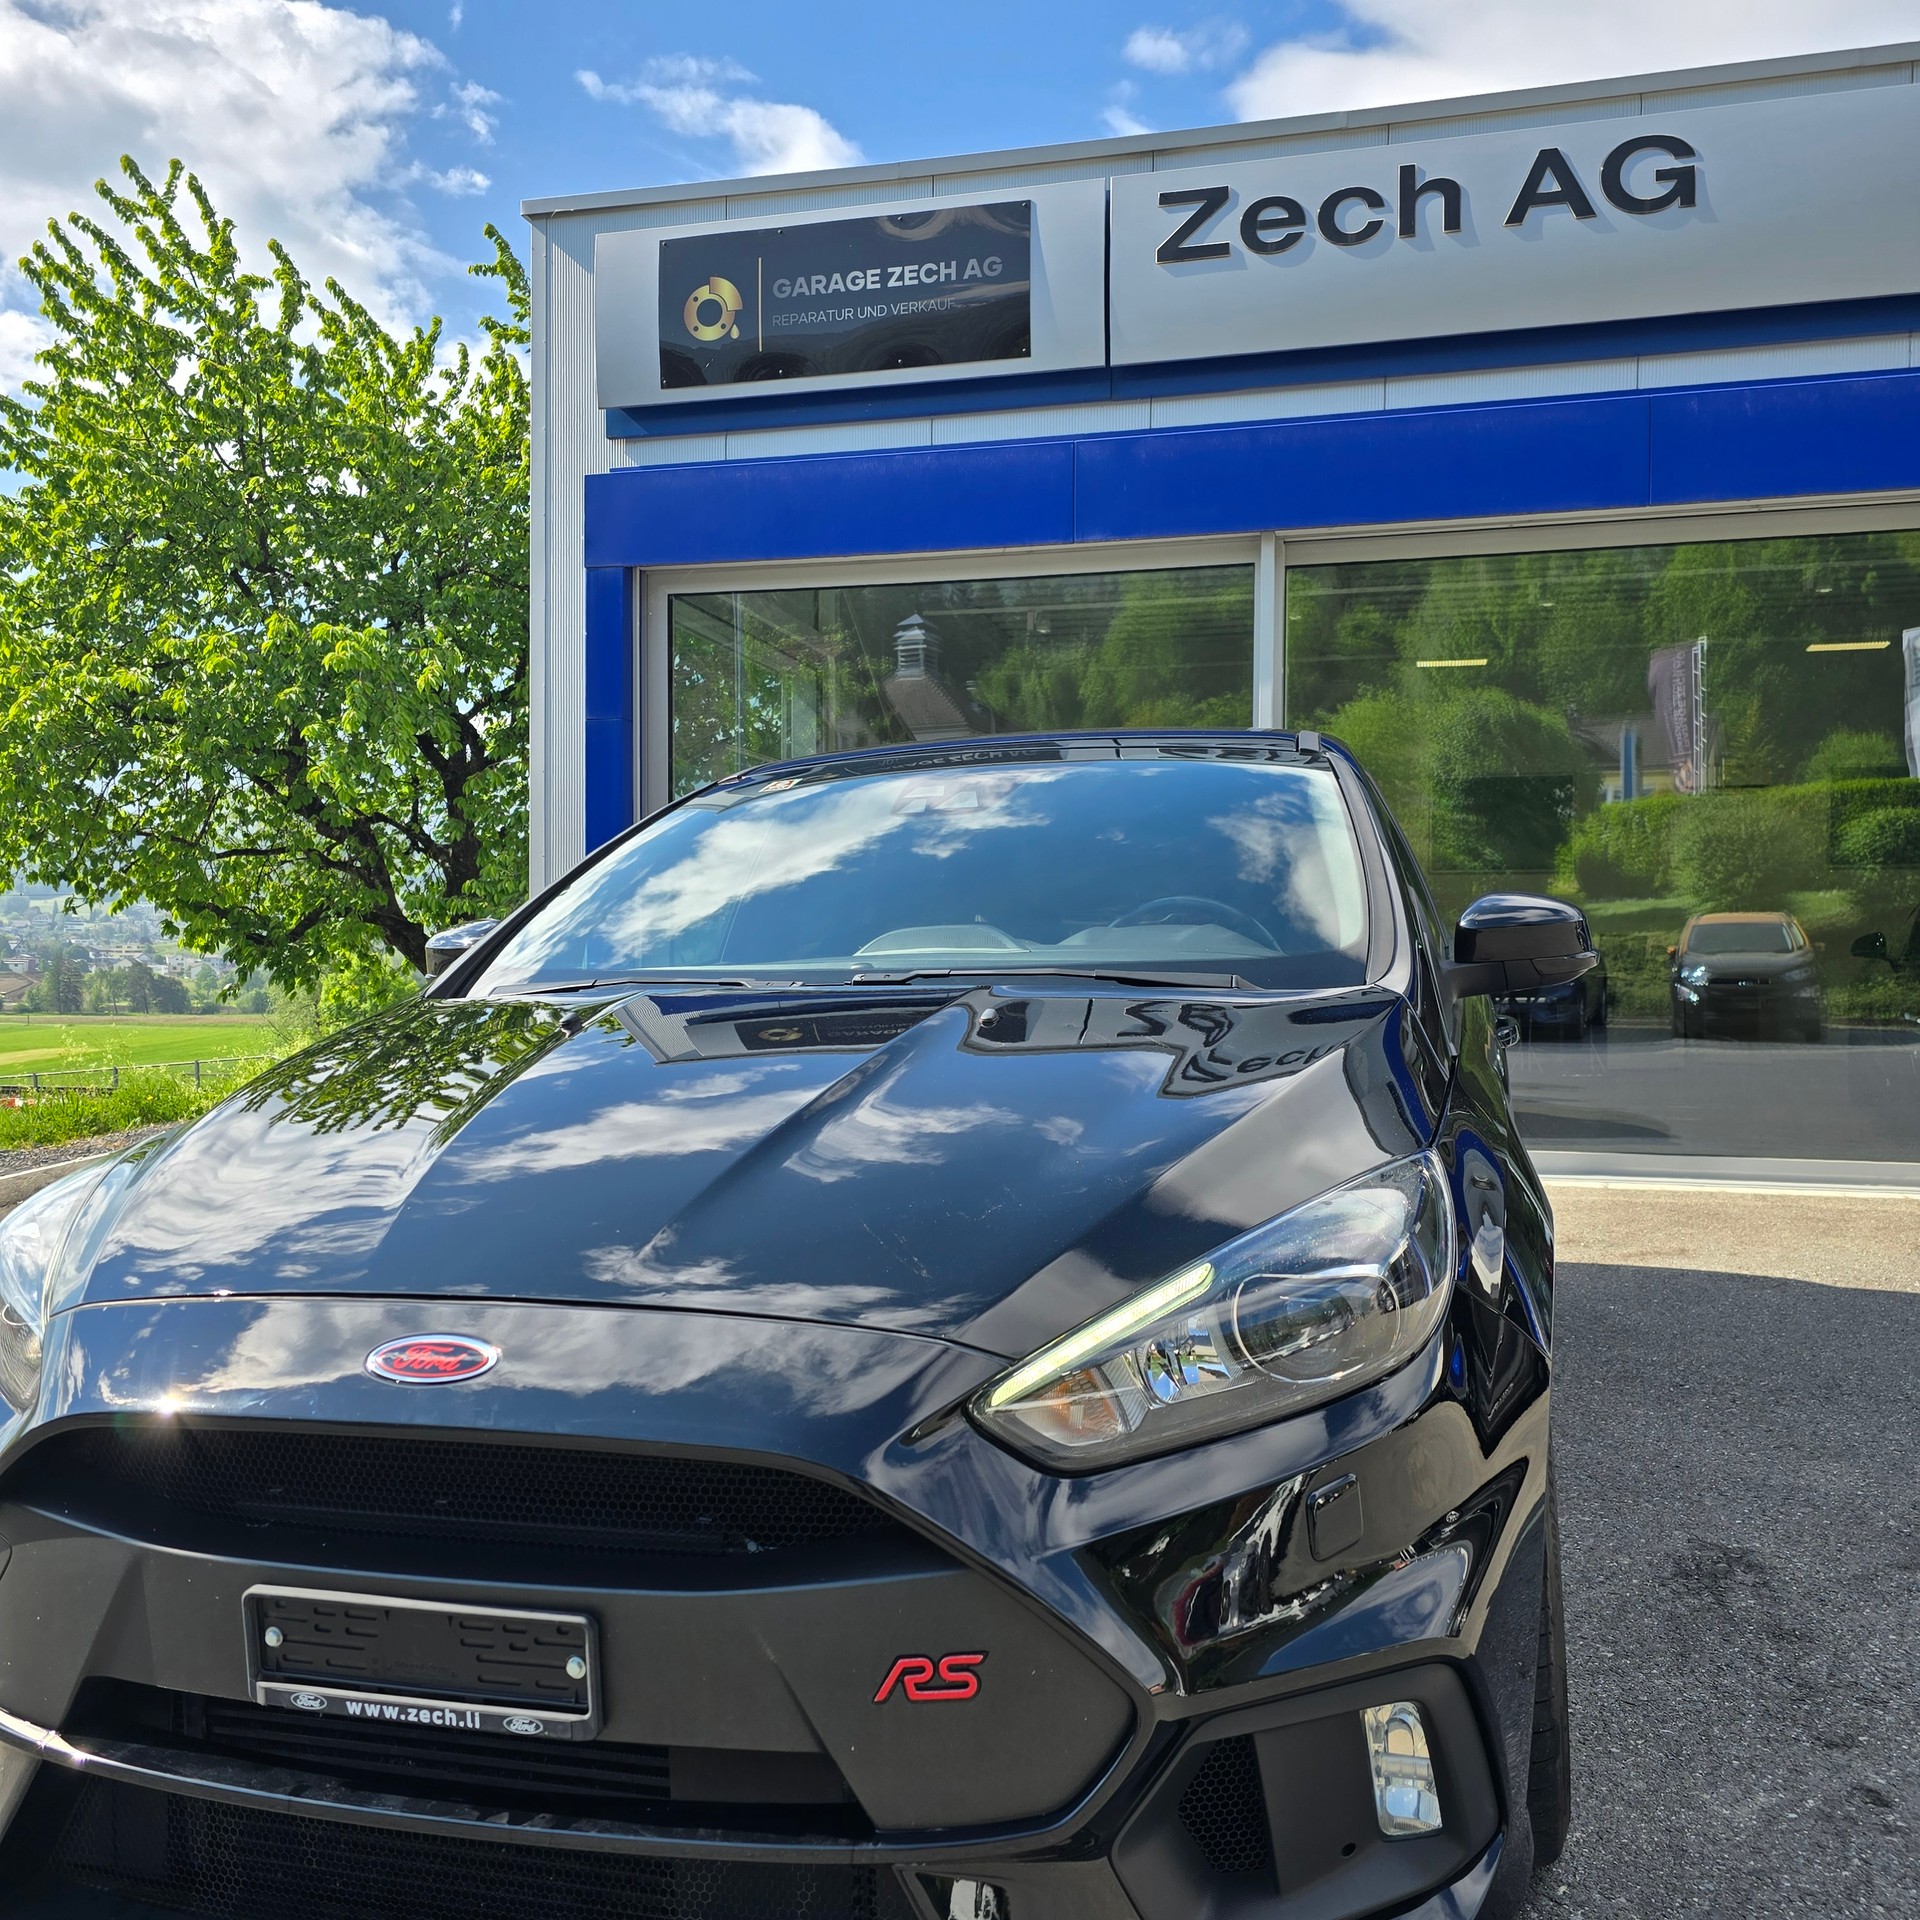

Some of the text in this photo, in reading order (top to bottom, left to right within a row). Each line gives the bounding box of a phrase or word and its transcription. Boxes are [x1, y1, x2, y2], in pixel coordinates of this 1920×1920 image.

[1155, 133, 1696, 264] Zech AG
[772, 256, 1003, 299] GARAGE ZECH AG
[772, 298, 956, 327] REPARATUR UND VERKAUF
[393, 1344, 469, 1371] Ford
[872, 1651, 989, 1704] RS
[296, 1693, 321, 1708] Ford
[345, 1700, 481, 1730] www.zech.li
[509, 1717, 537, 1732] Ford
